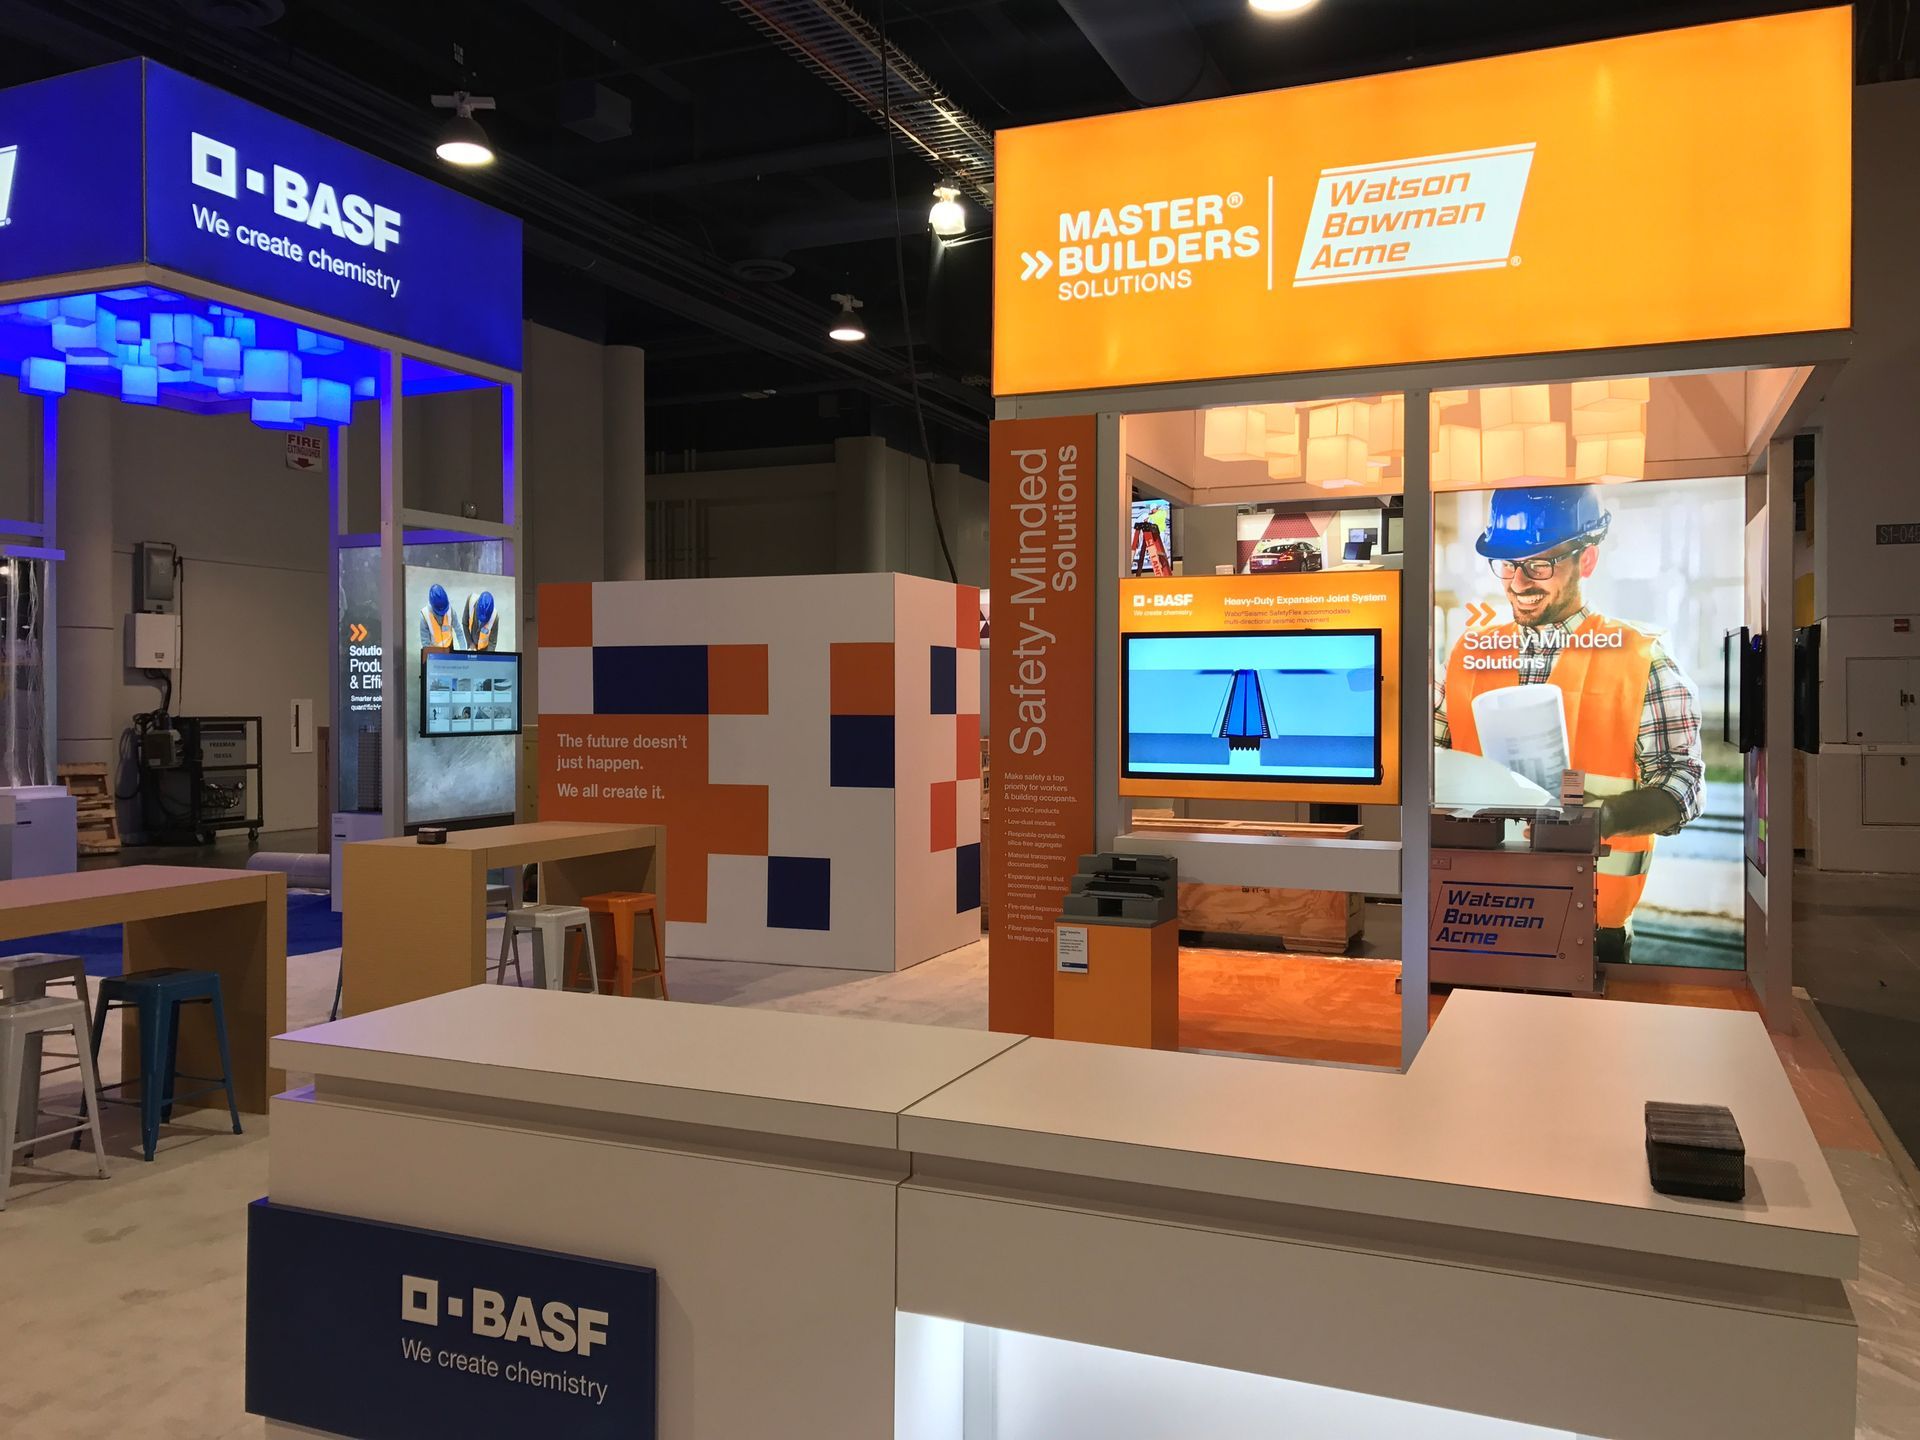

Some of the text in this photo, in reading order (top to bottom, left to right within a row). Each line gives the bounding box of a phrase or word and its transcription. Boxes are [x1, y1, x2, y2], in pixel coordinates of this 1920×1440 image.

[1330, 172, 1471, 207] Watson
[274, 164, 400, 253] BASF
[1322, 202, 1486, 238] Bowman
[192, 203, 400, 298] We create chemistry
[1058, 225, 1260, 277] BUILDERS
[1310, 241, 1410, 271] Acme
[1058, 268, 1192, 301] SOLUTIONS
[287, 433, 321, 449] FIRE
[1052, 444, 1077, 592] Solutions
[1009, 448, 1056, 756] Safety-Minded
[1153, 593, 1194, 607] BASF
[1224, 593, 1387, 607] Heavy-Duty Expansion Joint System
[1463, 629, 1623, 654] Safety-Minded
[1463, 655, 1546, 670] Solutions
[350, 675, 359, 689] &
[557, 733, 688, 749] The future doesn't
[556, 755, 644, 772] just happen.
[1004, 772, 1023, 780] Make
[1024, 773, 1045, 782] safety
[1052, 774, 1064, 783] top
[1004, 783, 1028, 792] priority
[1040, 784, 1068, 792] workers
[557, 783, 665, 799] We all create it.
[1011, 793, 1038, 802] building
[1448, 889, 1535, 910] Watson
[1443, 908, 1544, 929] Bowman
[1435, 927, 1498, 945] Acme
[472, 1287, 609, 1357] BASF
[401, 1337, 608, 1405] We create chemistry
